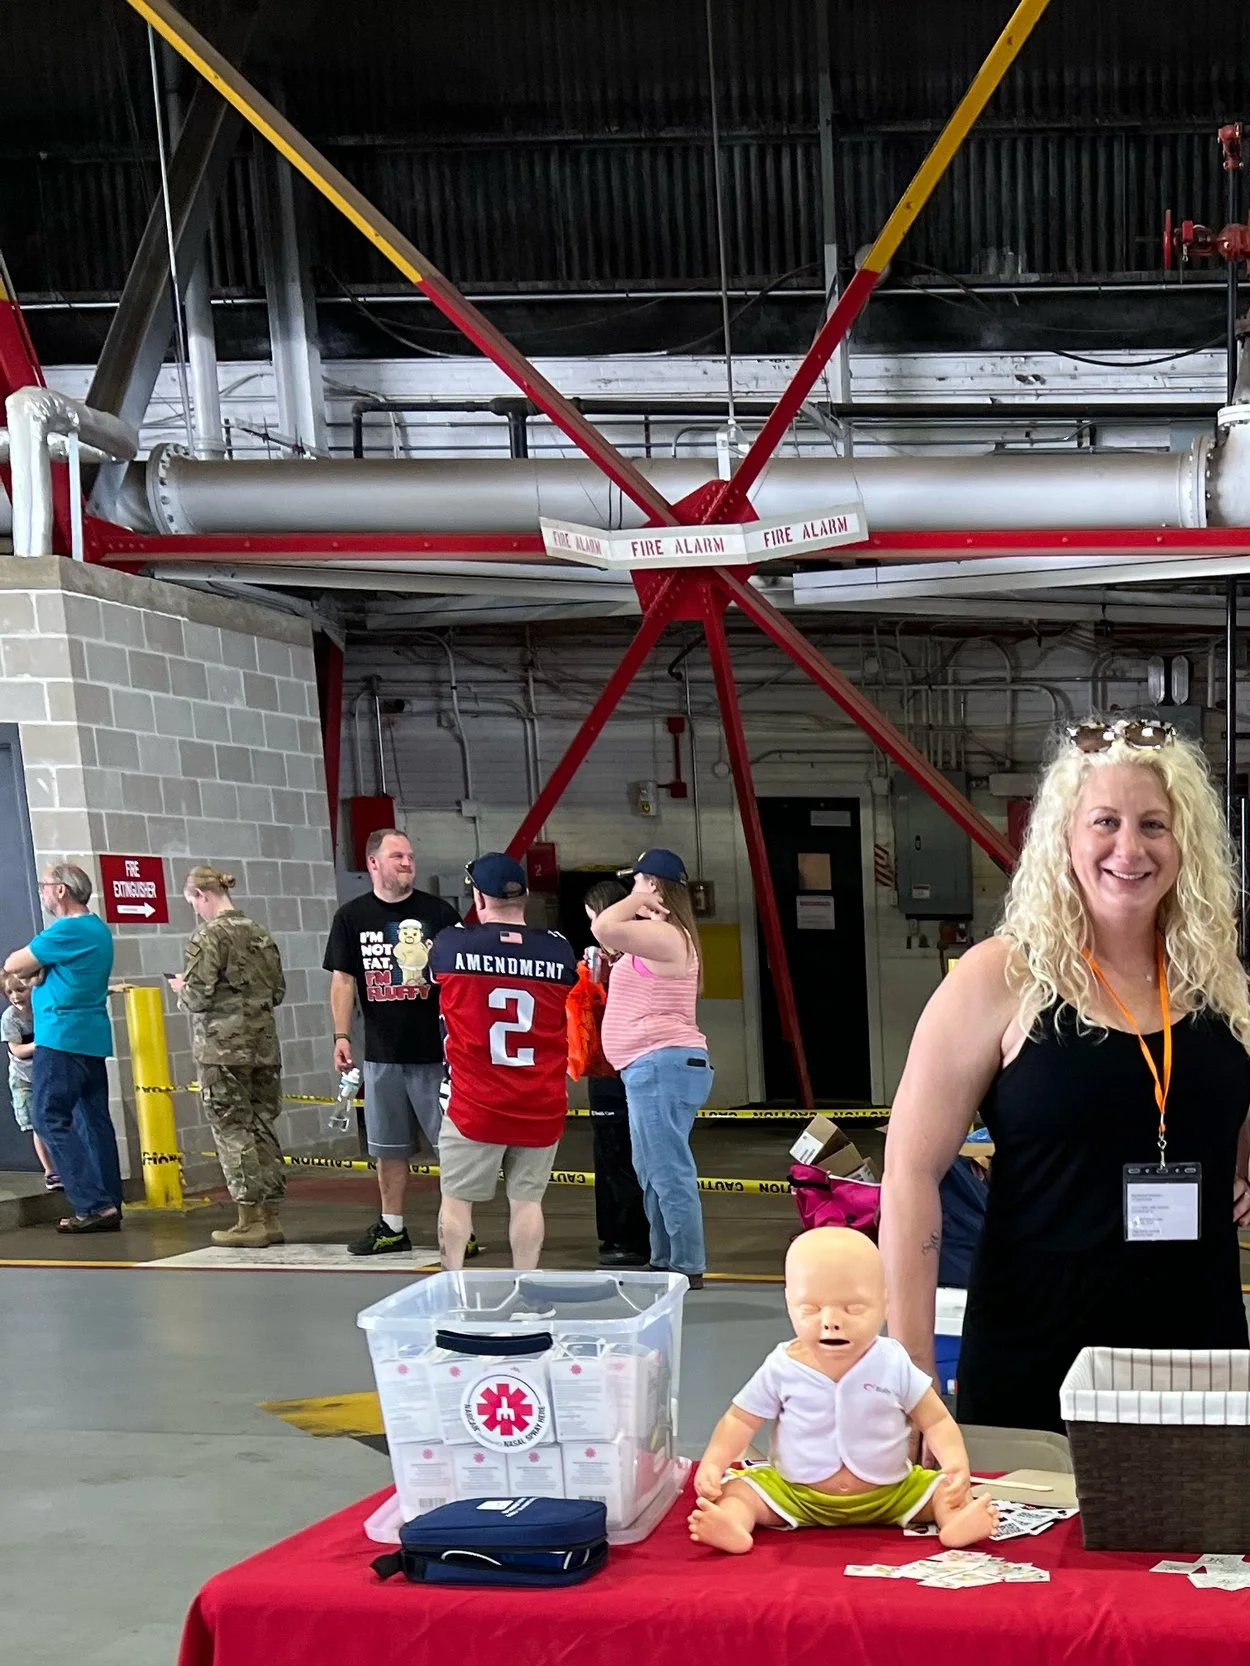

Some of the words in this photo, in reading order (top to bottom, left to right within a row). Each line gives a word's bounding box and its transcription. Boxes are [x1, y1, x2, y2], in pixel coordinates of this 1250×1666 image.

[763, 526, 793, 548] FIRE
[801, 516, 848, 539] ALARM
[552, 531, 571, 548] FIRE
[575, 539, 602, 553] ALARM
[631, 539, 664, 557] FIRE
[675, 536, 725, 554] ALARM
[125, 860, 140, 877] FIRE
[112, 880, 157, 898] EXTINGUISHER
[360, 931, 383, 944] I'M
[361, 943, 393, 957] NOT
[363, 957, 393, 970] FAT,
[455, 952, 564, 980] AMENDMENT
[365, 970, 391, 986] I'M
[367, 984, 431, 1001] FLUFFY
[488, 987, 536, 1067] 2
[697, 1180, 744, 1192] CAUTI
[503, 1438, 526, 1448] NASAL
[526, 1422, 543, 1441] SPRAY
[538, 1406, 546, 1423] HERE
